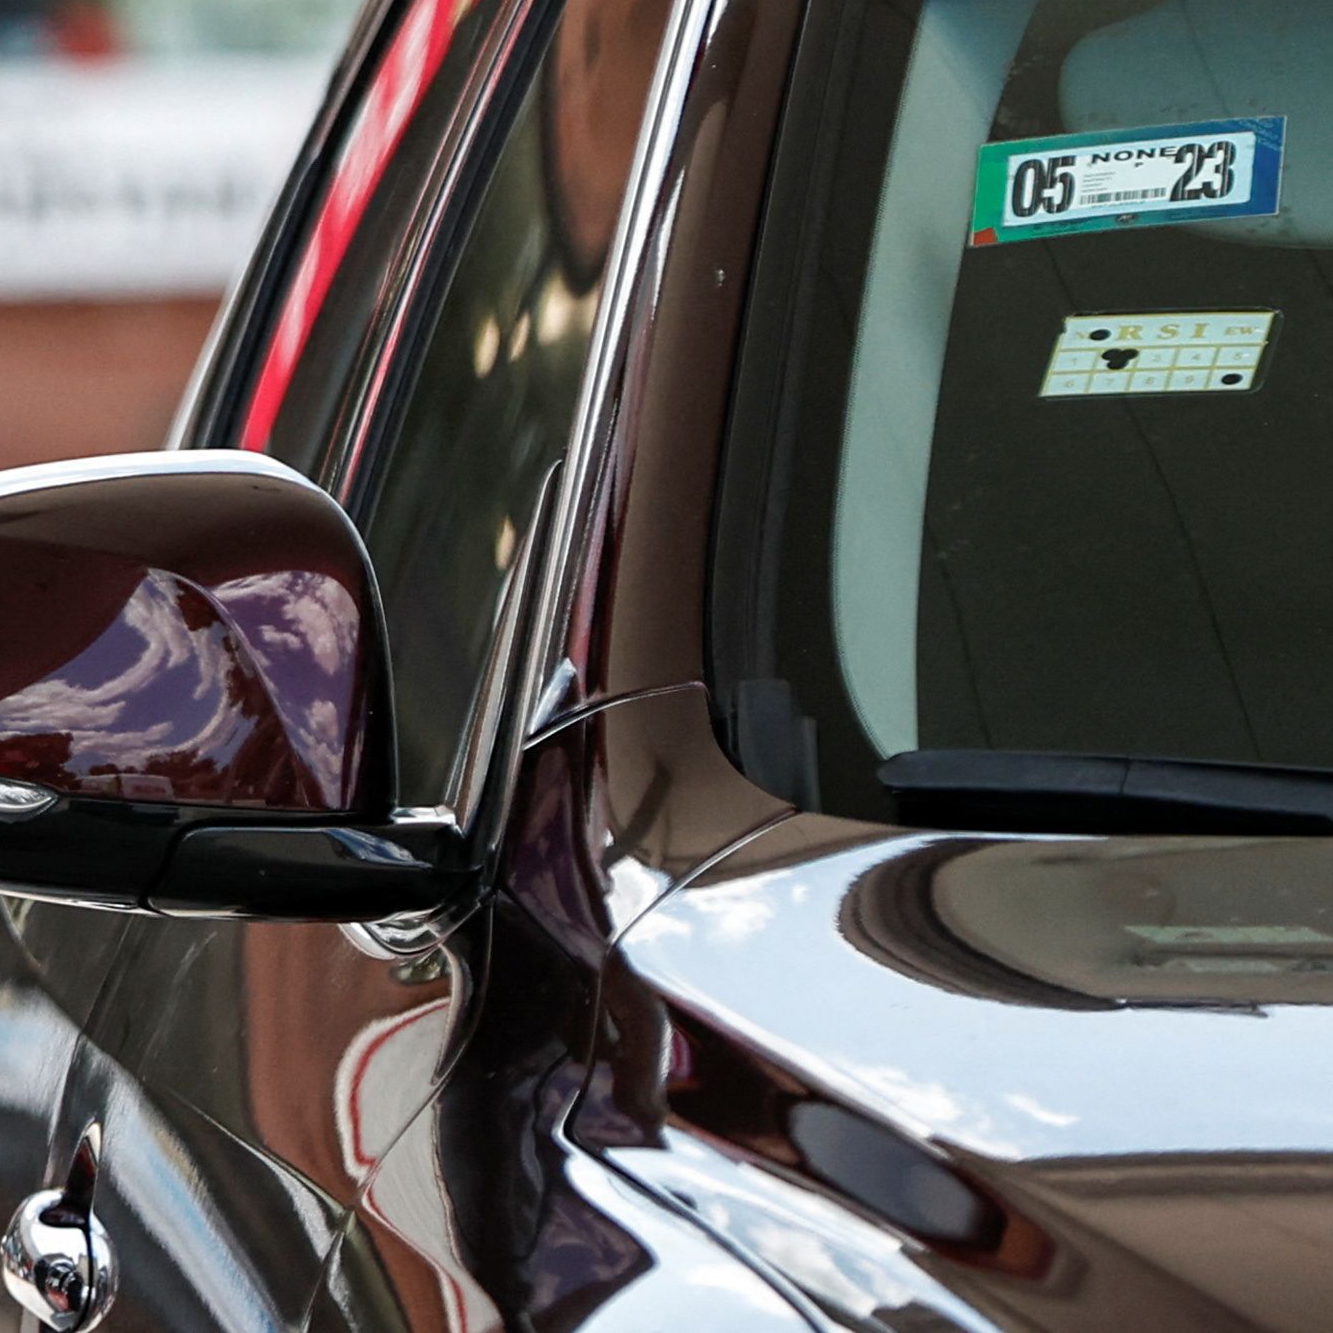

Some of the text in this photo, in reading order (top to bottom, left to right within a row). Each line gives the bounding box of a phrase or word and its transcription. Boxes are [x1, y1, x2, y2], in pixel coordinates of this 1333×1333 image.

[1012, 141, 1237, 218] 05 NONE 23
[1117, 325, 1144, 341] R
[1156, 324, 1179, 340] S
[1190, 322, 1210, 339] I
